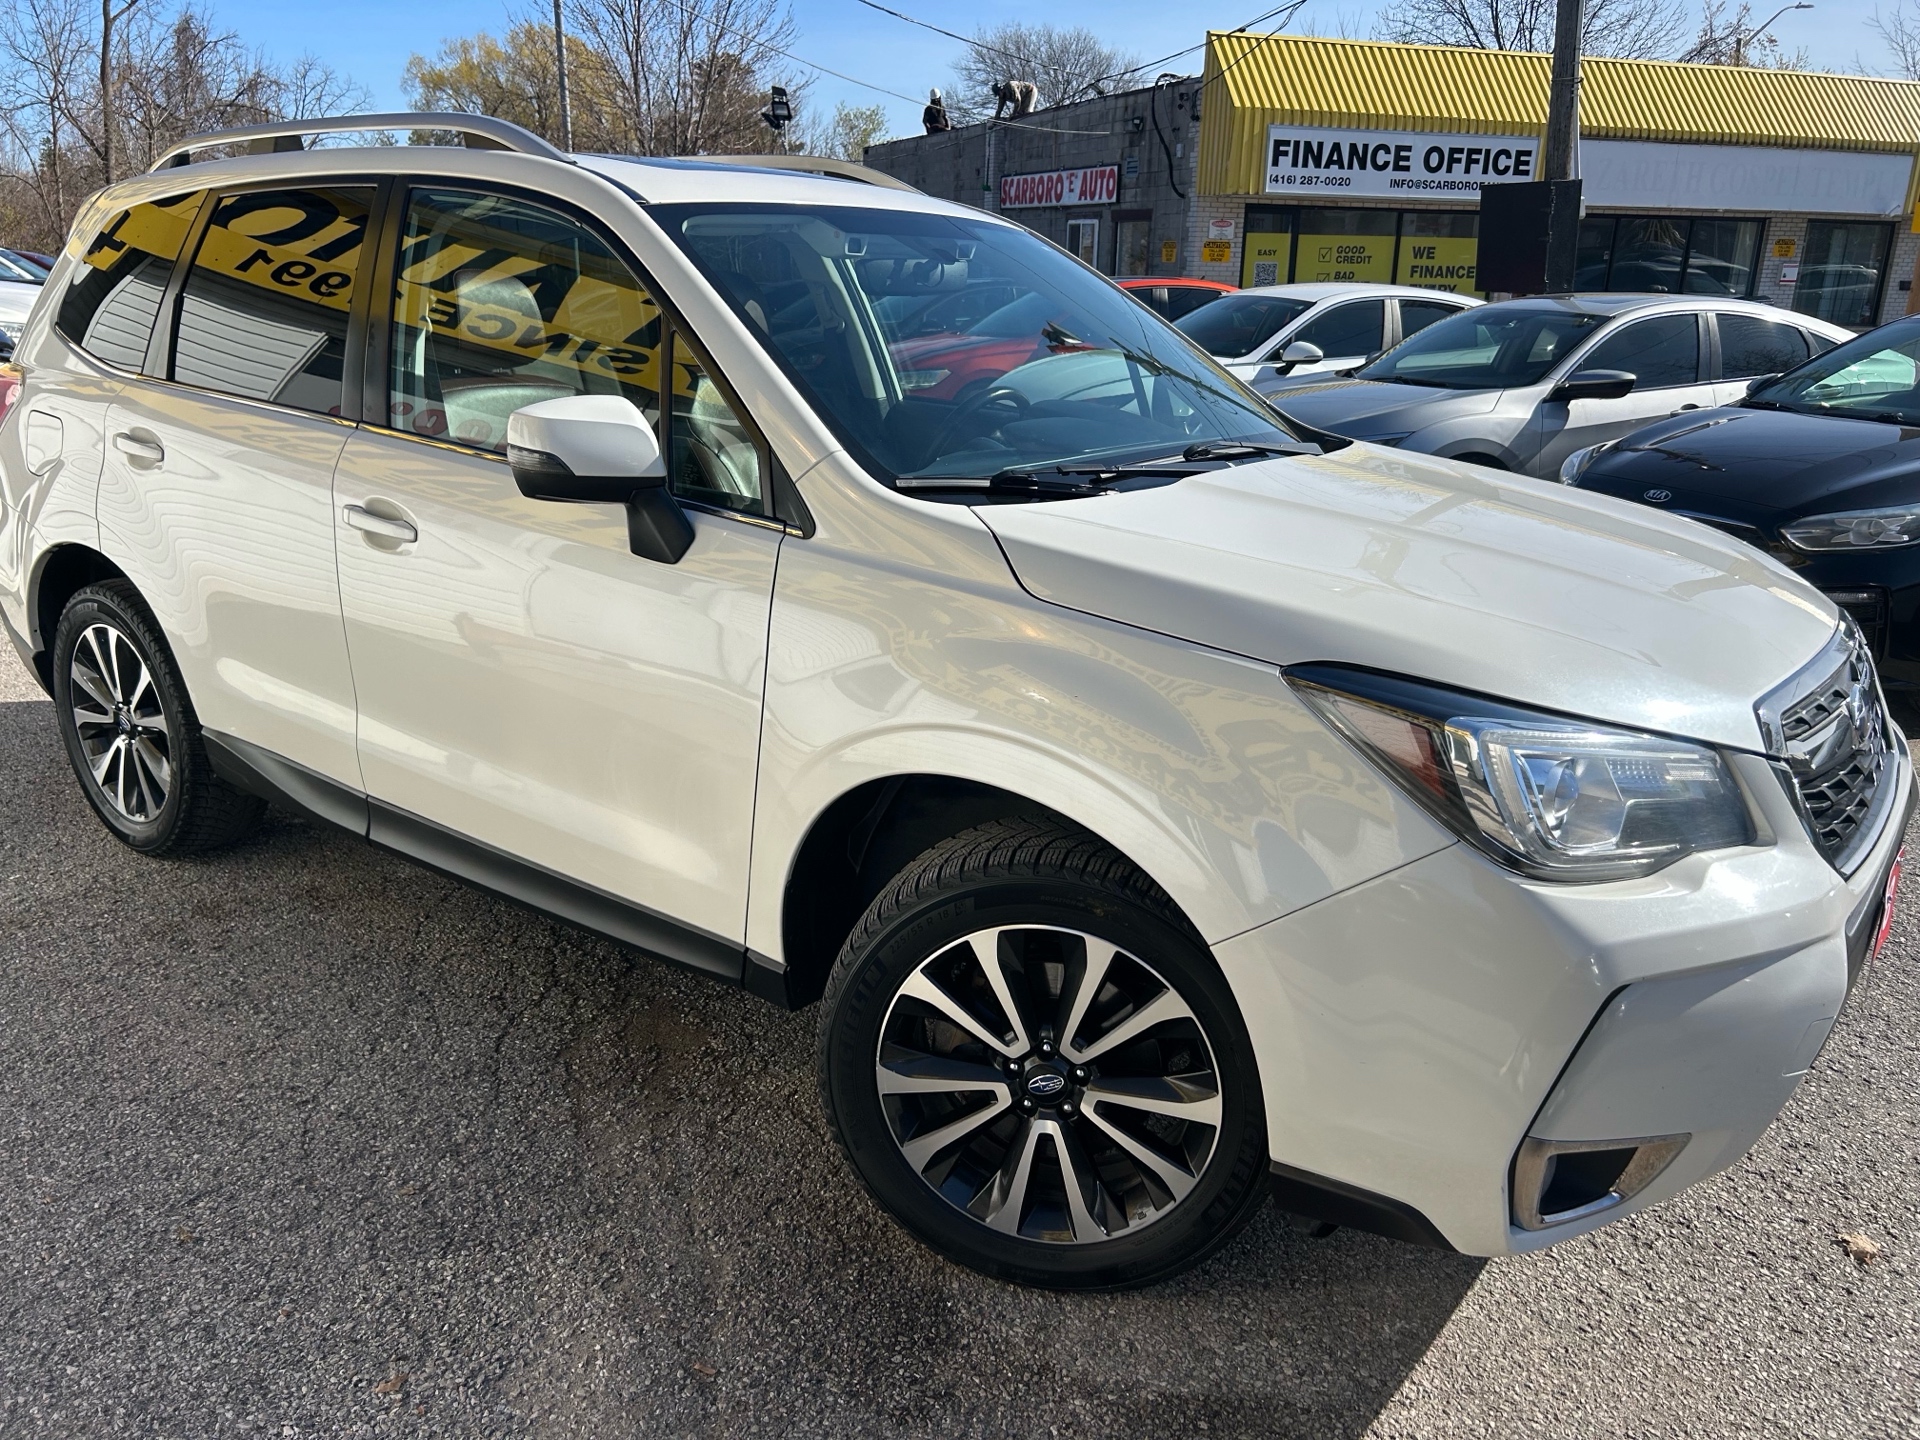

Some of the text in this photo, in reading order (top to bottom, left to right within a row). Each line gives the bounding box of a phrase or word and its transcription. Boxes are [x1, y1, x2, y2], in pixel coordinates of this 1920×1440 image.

[1271, 139, 1533, 176] FINANCE OFFICE
[1001, 173, 1064, 206] SCARBORO
[1078, 168, 1116, 201] AUTO
[1269, 174, 1351, 187] (416) 287-0020
[1336, 245, 1366, 255] GOOD
[1412, 246, 1436, 260] WE
[1335, 255, 1372, 265] CREDIT
[1333, 271, 1355, 280] BAD
[1409, 265, 1476, 279] FINANCE
[1645, 489, 1668, 500] KIA
[889, 909, 950, 954] 225/55 R 18
